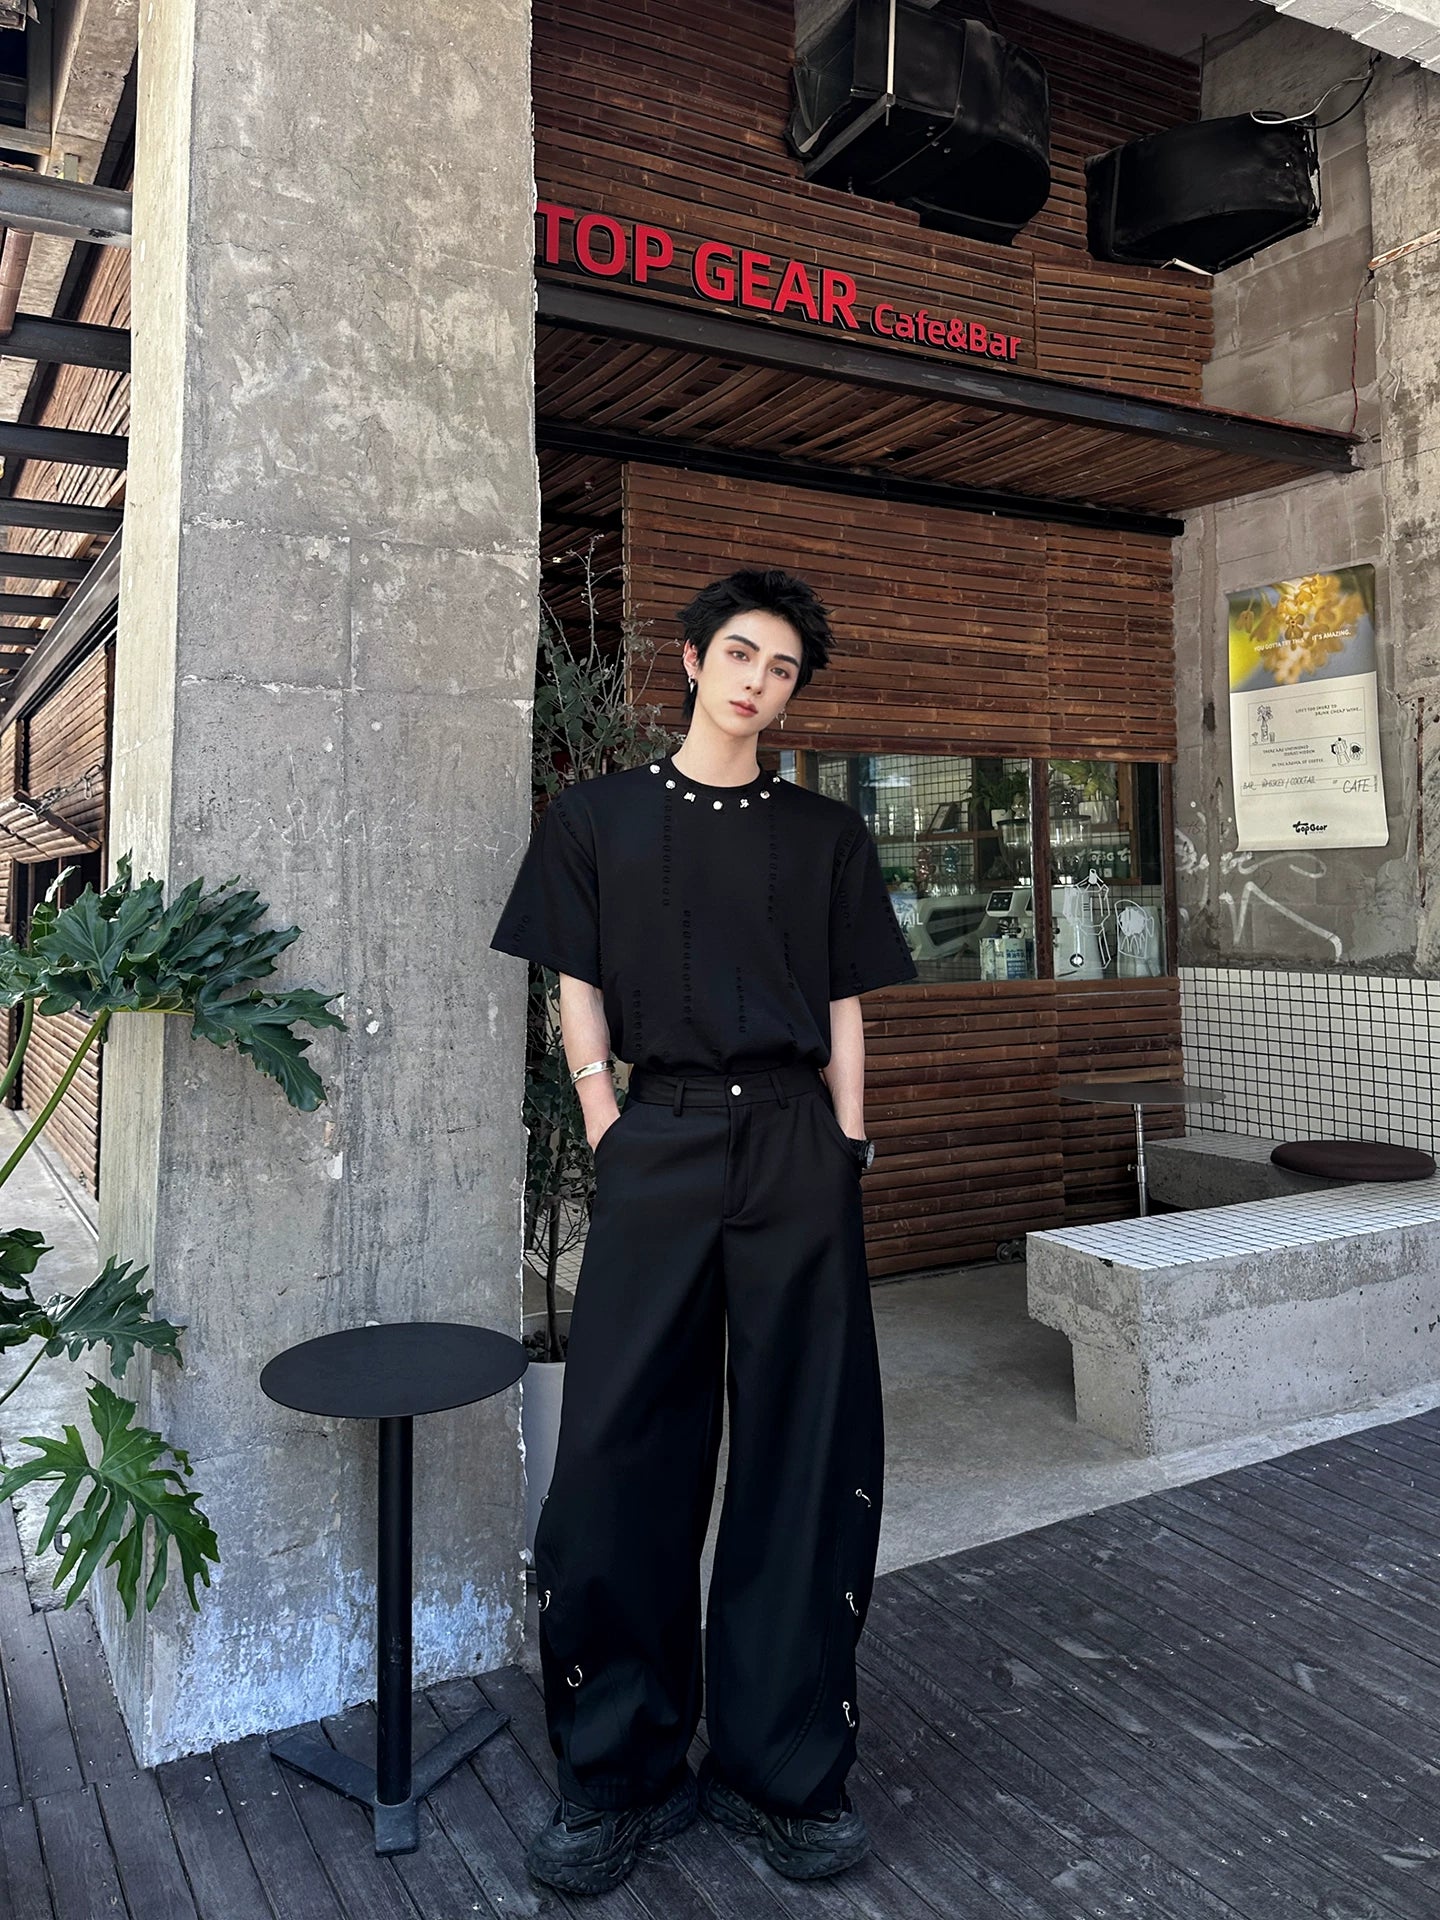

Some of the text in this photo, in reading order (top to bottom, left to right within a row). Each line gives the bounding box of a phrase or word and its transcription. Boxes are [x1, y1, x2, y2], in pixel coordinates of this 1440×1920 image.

[536, 202, 1022, 360] TOP GEAR Cafe&Bar
[1342, 778, 1370, 794] CAFE
